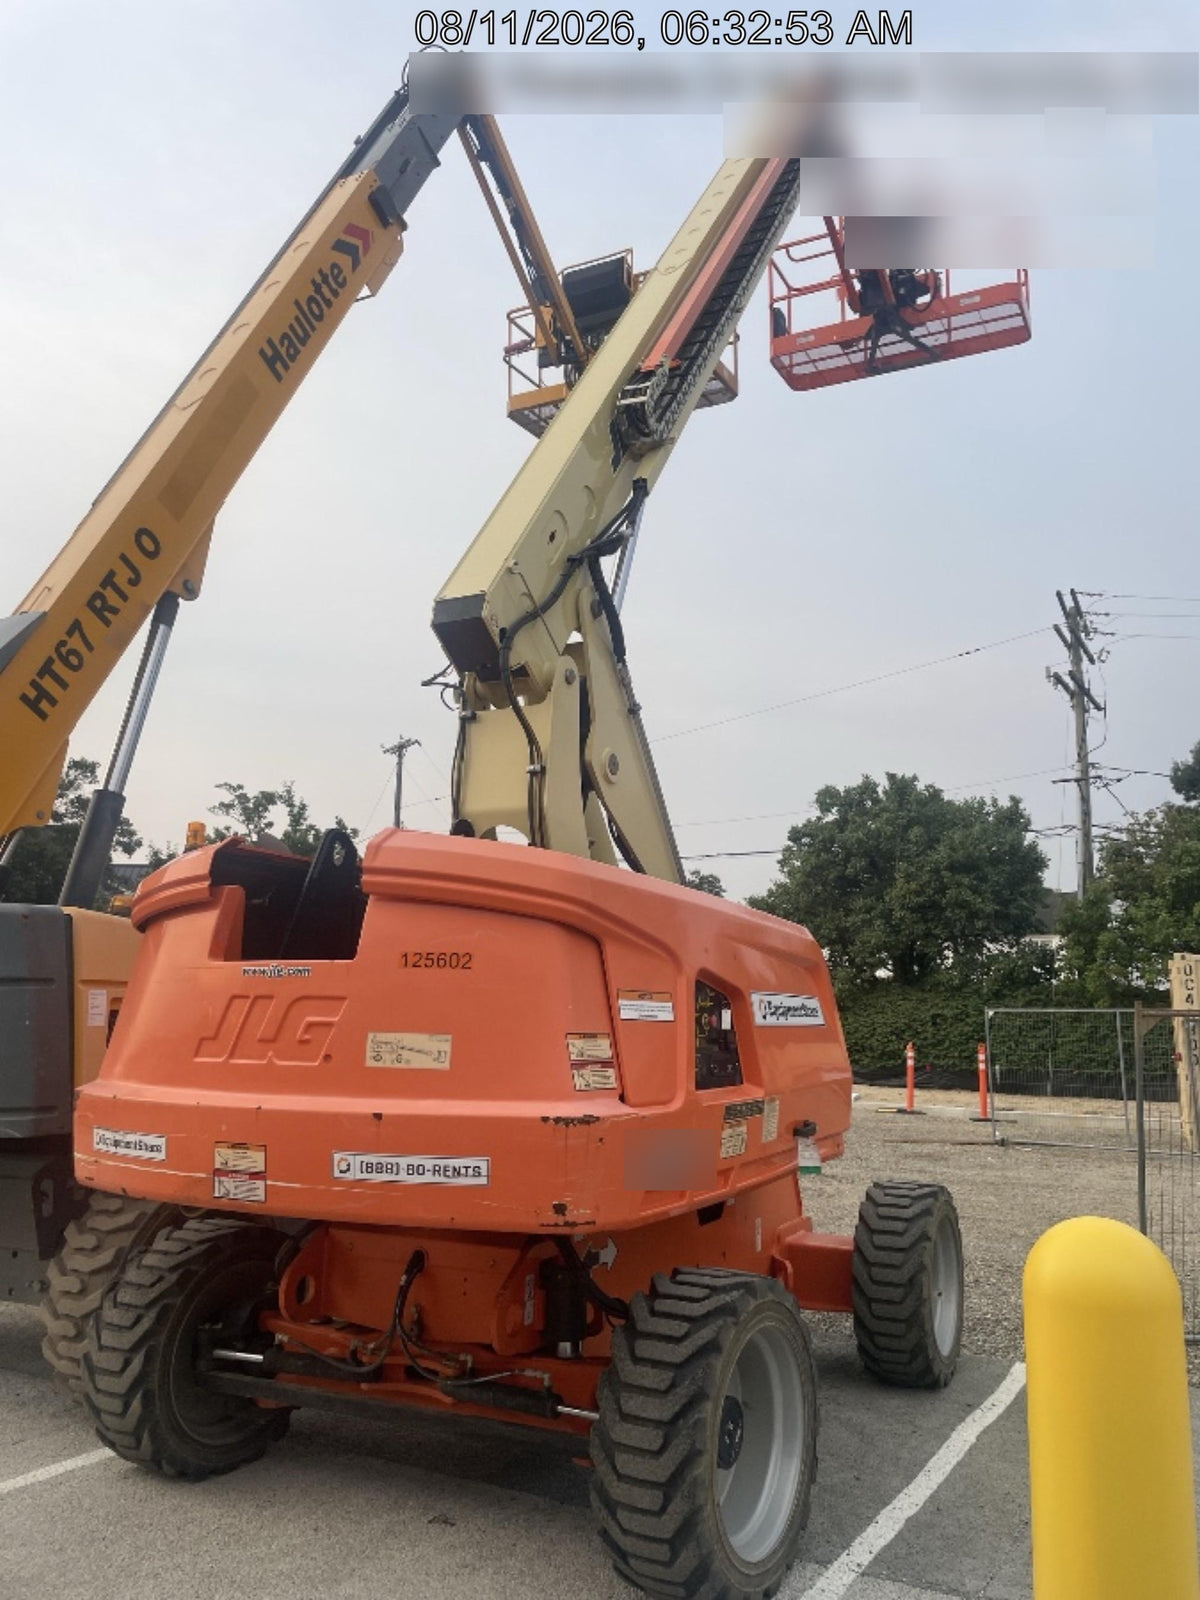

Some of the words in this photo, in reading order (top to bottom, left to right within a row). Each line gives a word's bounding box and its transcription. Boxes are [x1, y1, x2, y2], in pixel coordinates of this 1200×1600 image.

[258, 262, 347, 383] Haulotte
[19, 618, 95, 722] HT67
[86, 553, 142, 628] RTJ
[401, 952, 472, 969] 125602
[194, 994, 349, 1066] JLG
